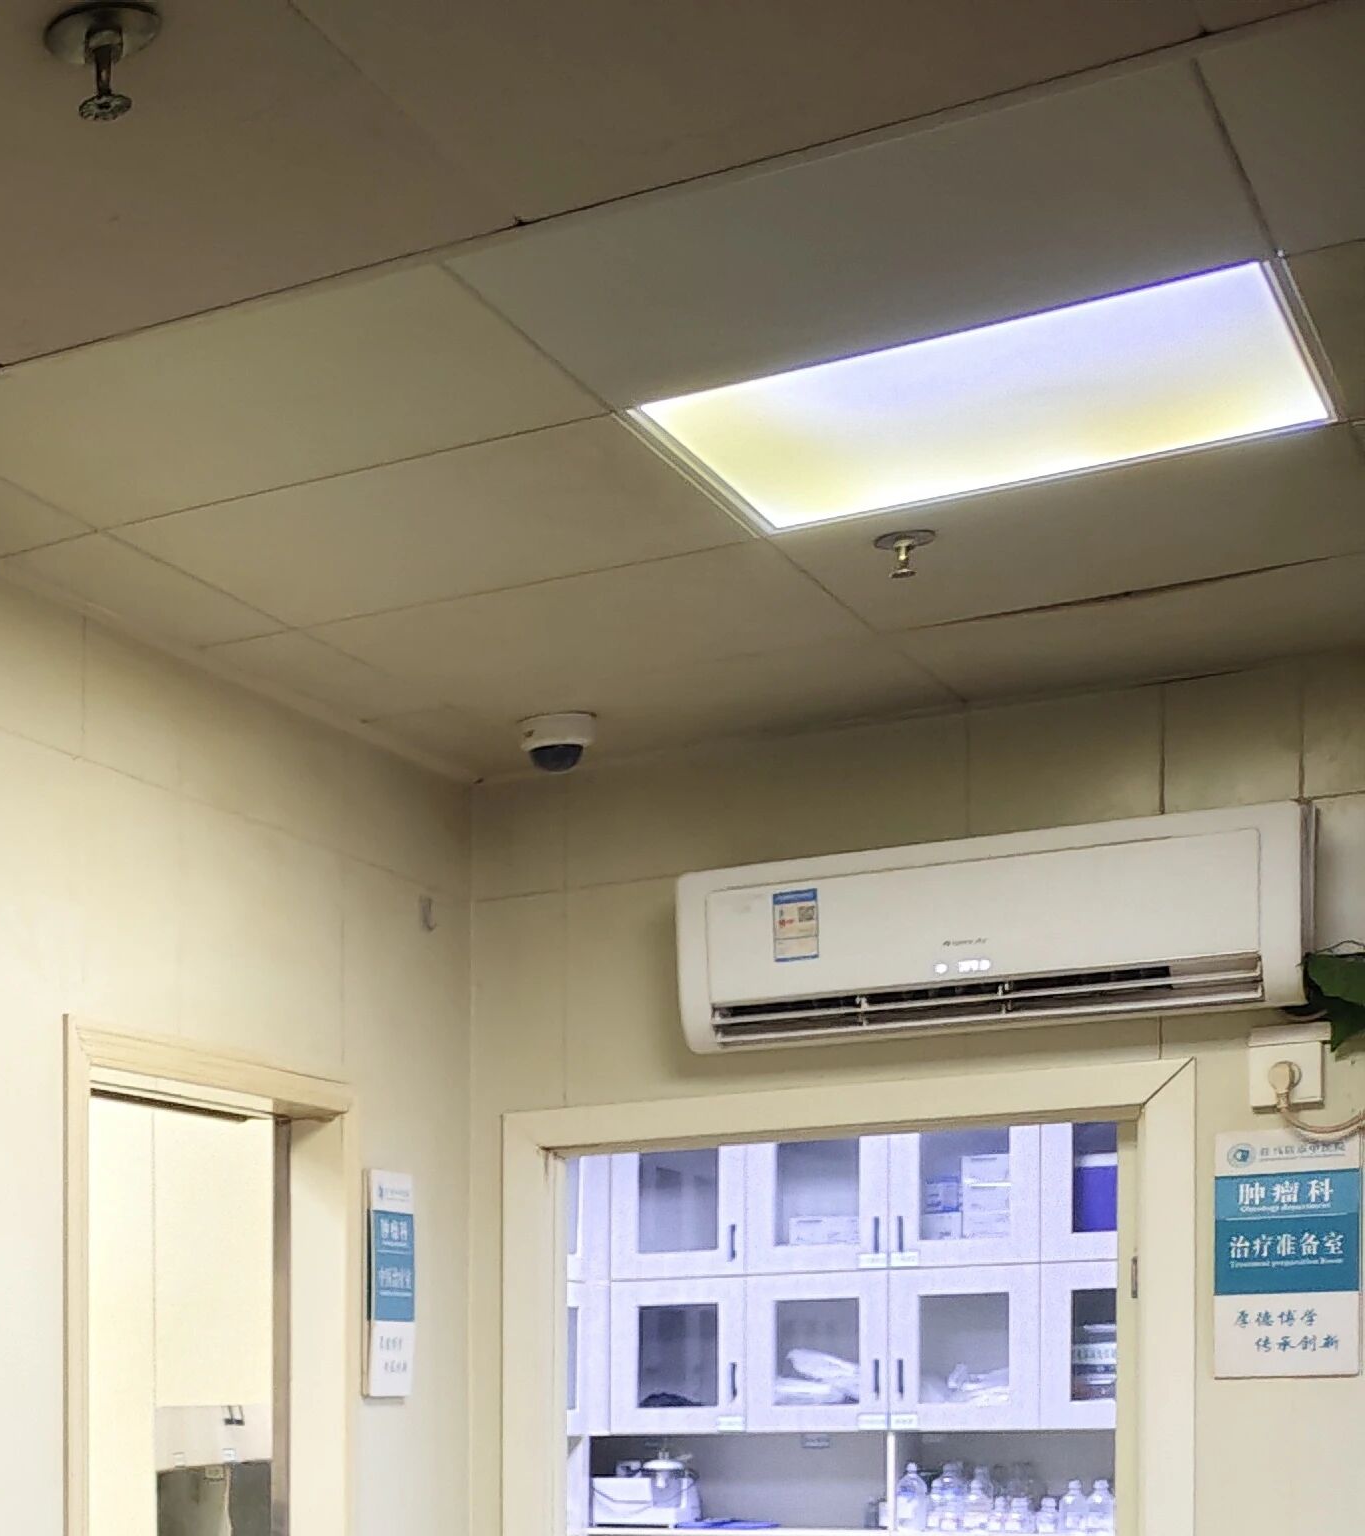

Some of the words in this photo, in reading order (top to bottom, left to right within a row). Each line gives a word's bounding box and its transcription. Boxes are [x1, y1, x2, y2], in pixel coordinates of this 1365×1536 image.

[1238, 1178, 1334, 1206] 肿瘤科
[1230, 1232, 1344, 1259] 治疗准备室
[1255, 1334, 1340, 1353] 传承创新
